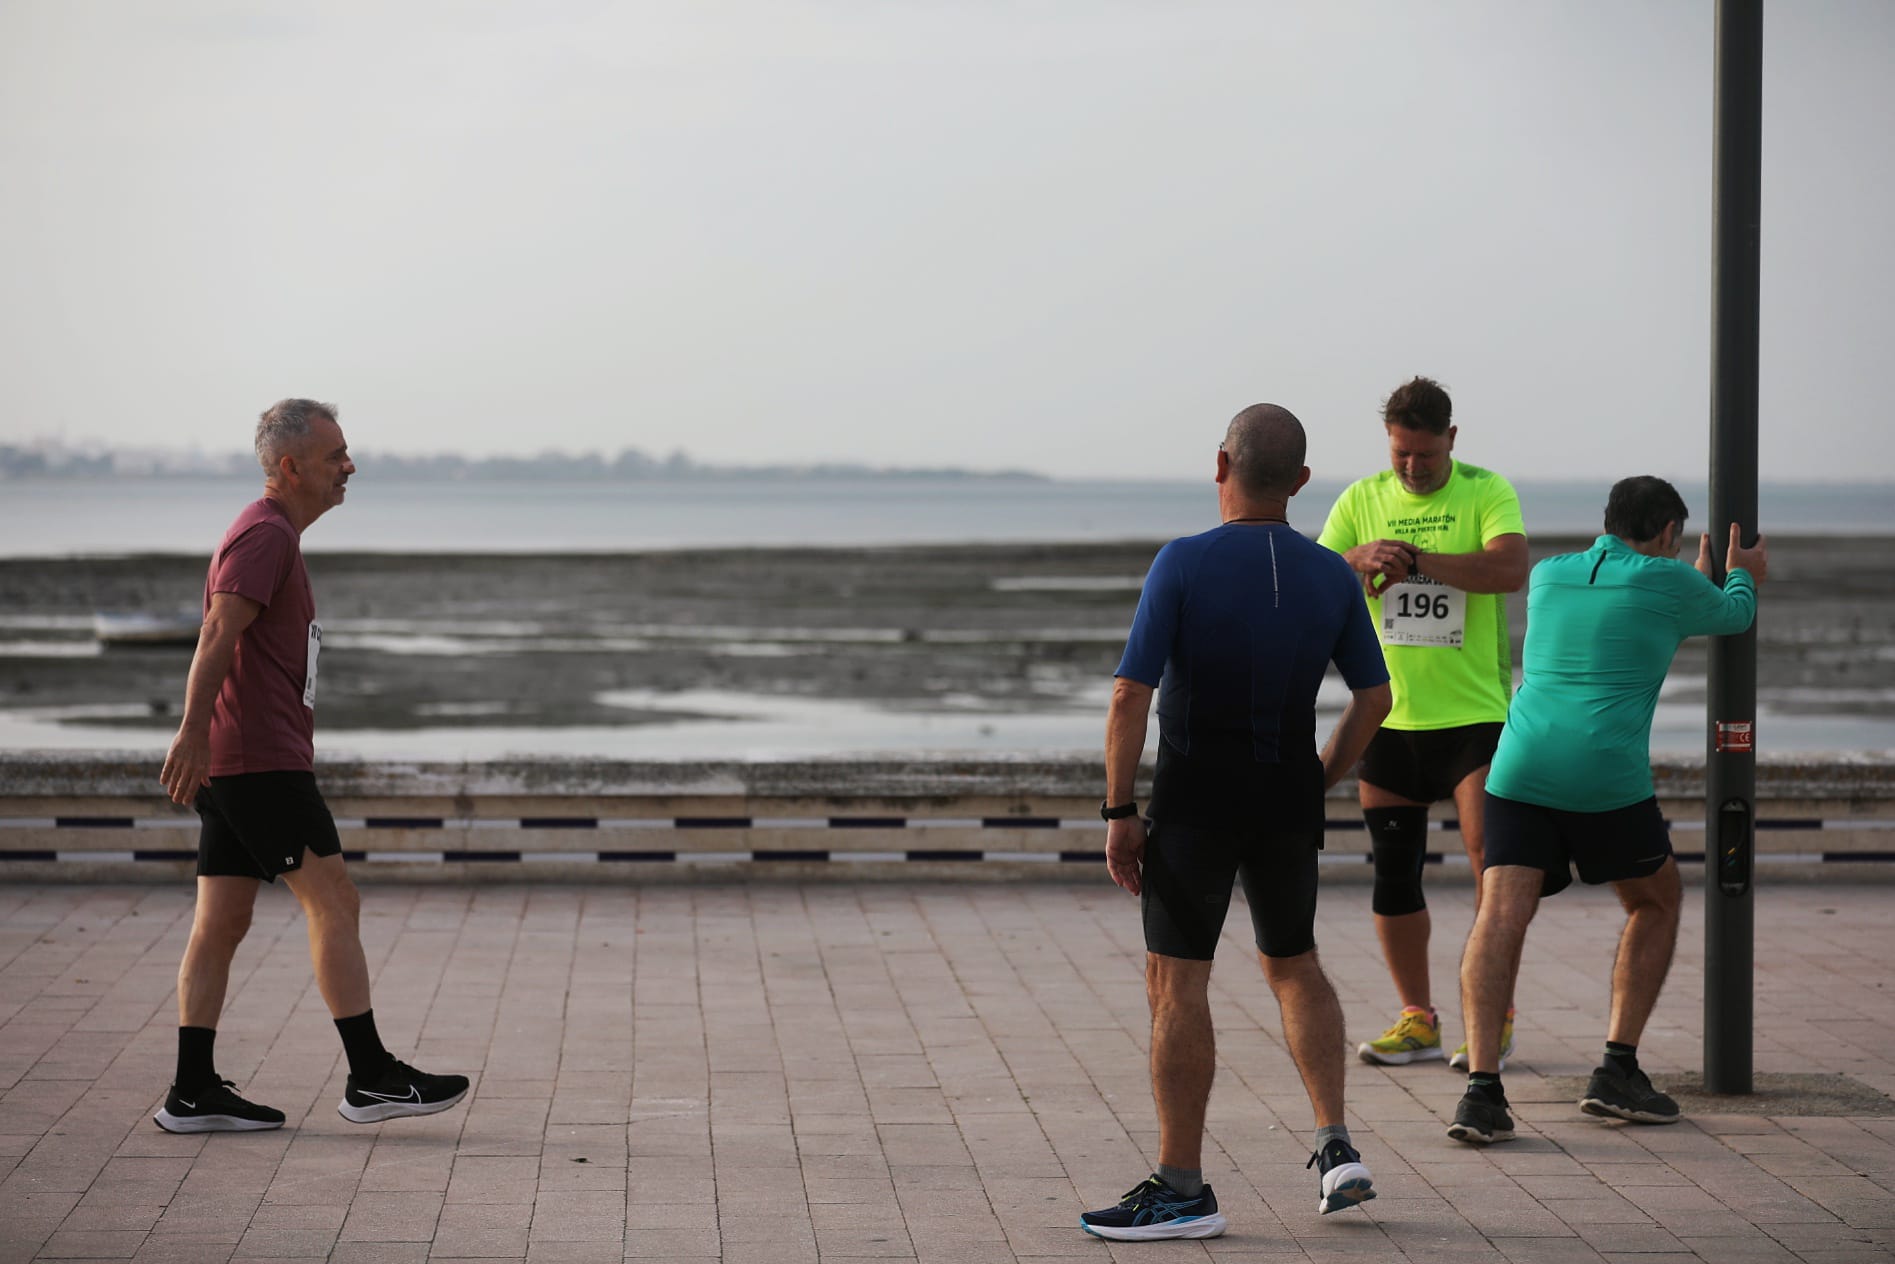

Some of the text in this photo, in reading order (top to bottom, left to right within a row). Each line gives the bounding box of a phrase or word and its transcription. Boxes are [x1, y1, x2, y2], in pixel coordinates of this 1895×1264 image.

[1398, 517, 1421, 527] MEDIA
[1422, 513, 1455, 524] MARATÓN
[1397, 592, 1449, 619] 196
